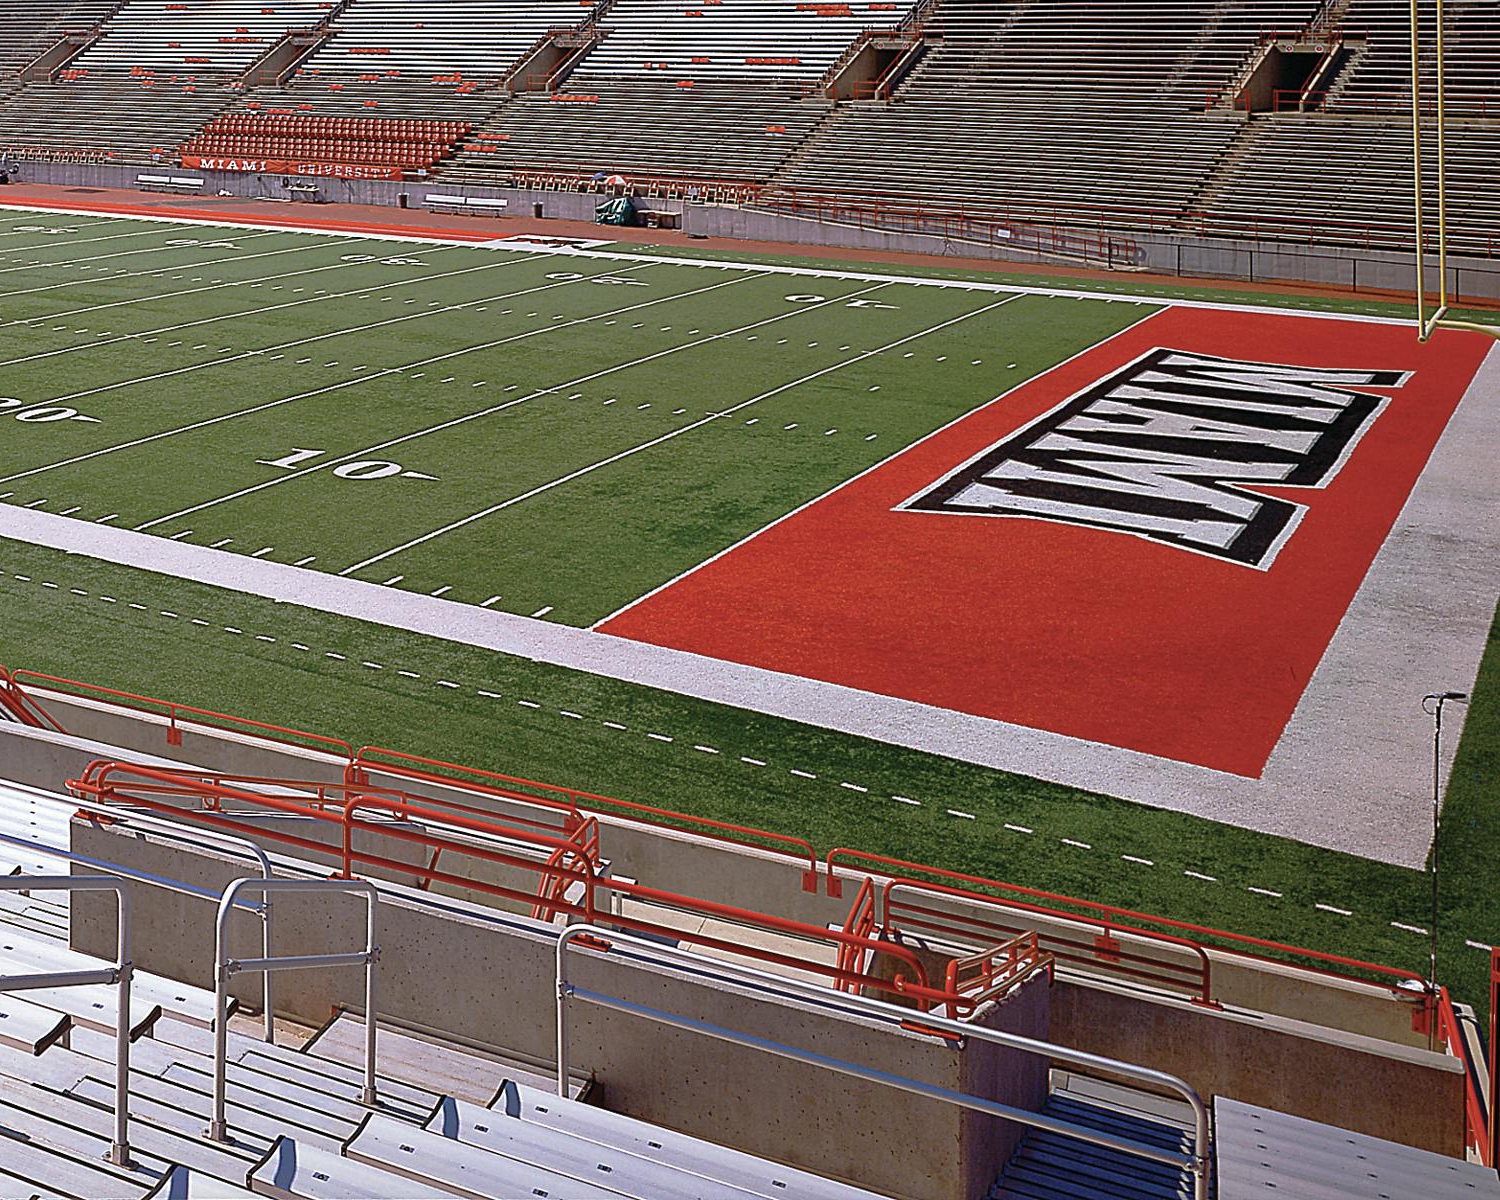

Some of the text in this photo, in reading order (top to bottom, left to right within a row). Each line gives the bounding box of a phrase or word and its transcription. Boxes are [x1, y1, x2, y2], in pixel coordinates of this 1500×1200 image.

[200, 158, 391, 178] MIAMI UNIVERSITY
[255, 448, 403, 480] 10
[943, 353, 1377, 550] MIAMI
